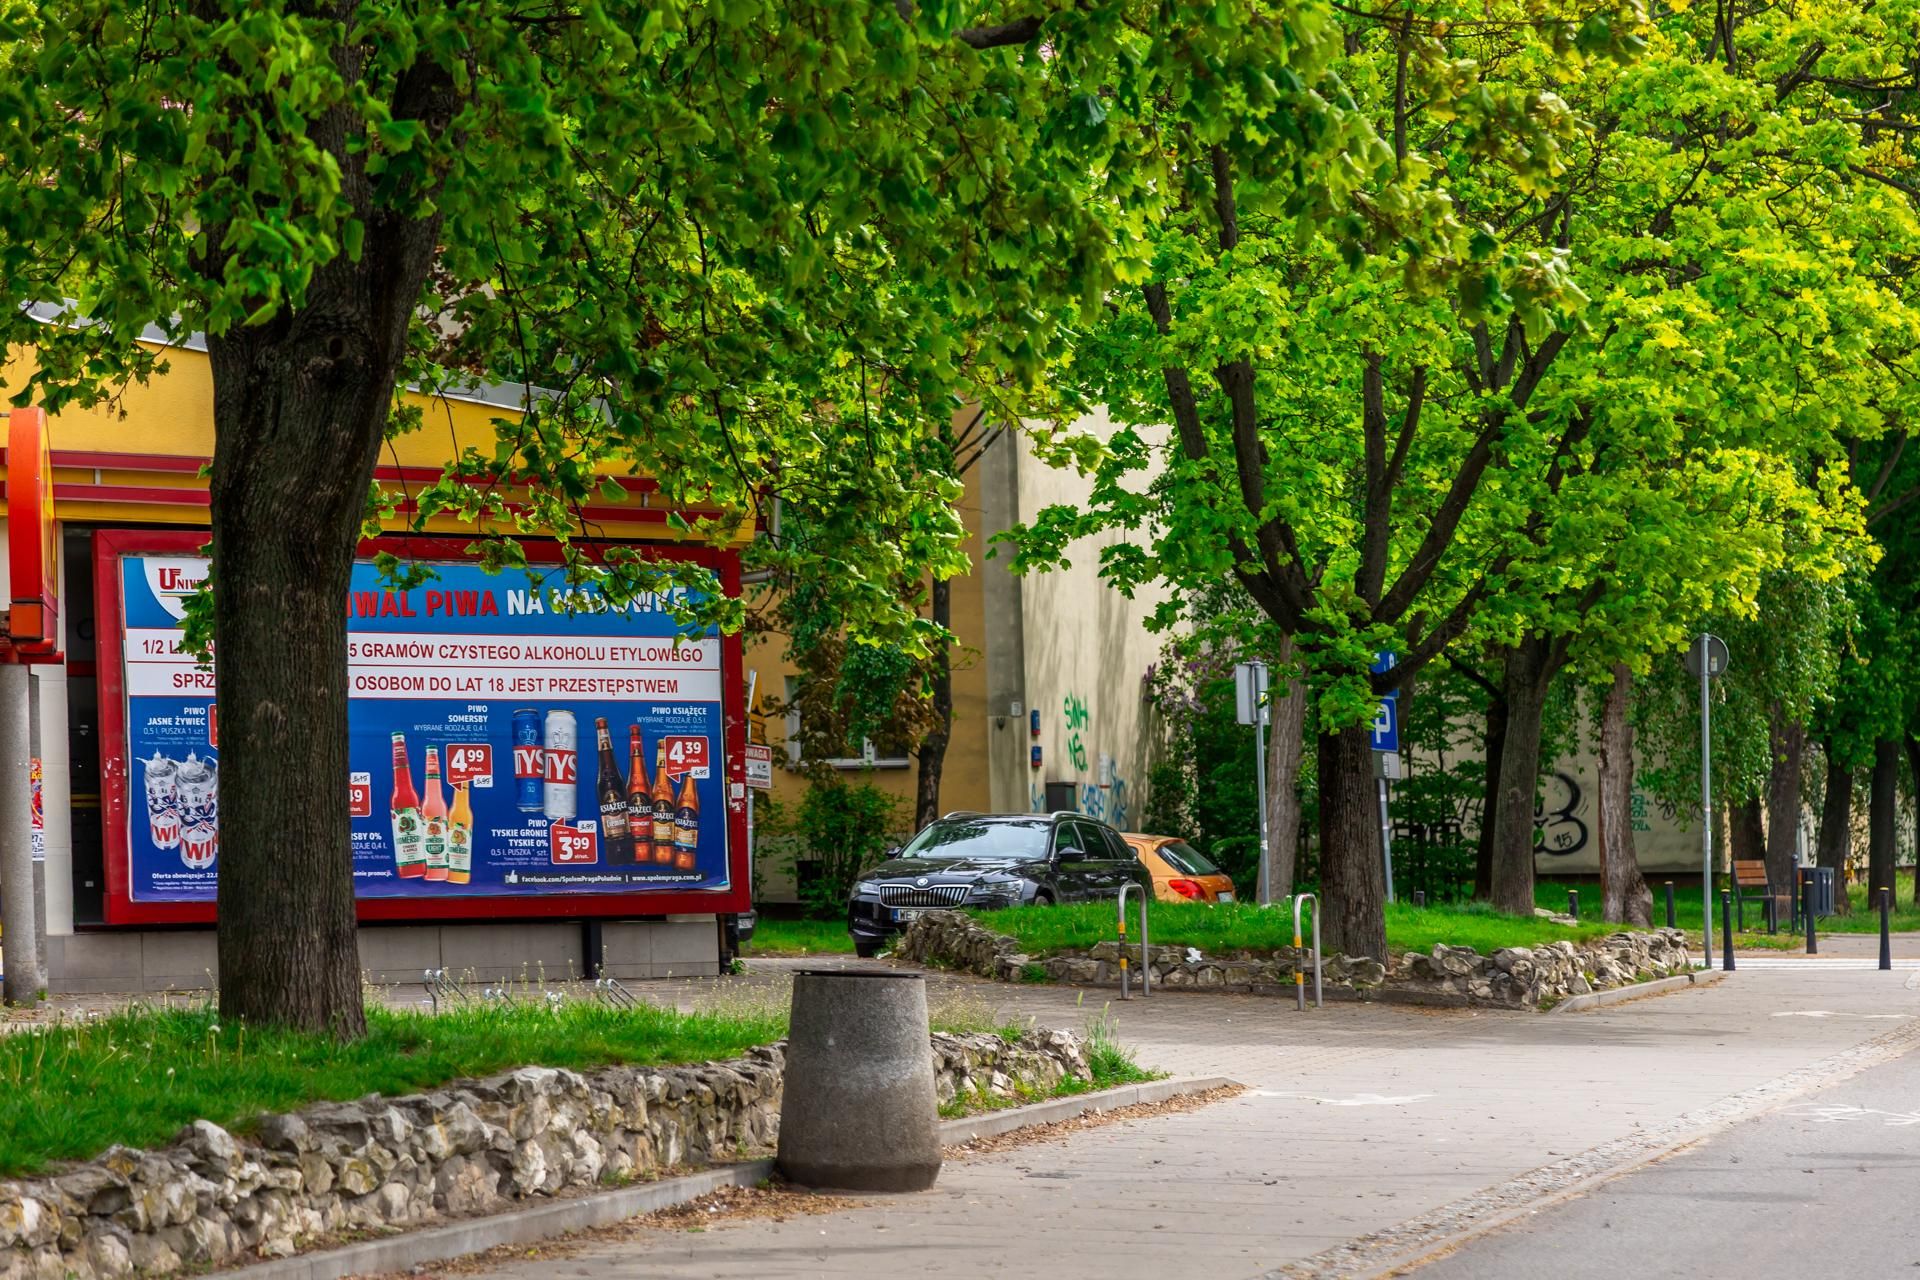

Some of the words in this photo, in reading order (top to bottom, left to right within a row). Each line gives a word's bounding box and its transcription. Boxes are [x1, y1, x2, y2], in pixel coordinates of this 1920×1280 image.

[426, 590, 499, 617] PIWA
[507, 589, 545, 615] NA
[142, 640, 164, 655] 1/2
[348, 643, 358, 658] 5
[362, 641, 434, 658] GRAMÓW
[439, 644, 520, 660] CZYSTEGO
[525, 646, 605, 661] ALKOHOLU
[611, 648, 703, 662] ETYLOWEGO
[173, 673, 216, 688] SPRZ
[356, 676, 424, 691] OSOBOM
[430, 677, 451, 692] DO
[457, 678, 483, 692] LAT
[488, 678, 504, 692] 18
[509, 678, 544, 692] JEST
[550, 678, 678, 696] PRZESTĘPSTWEM
[184, 707, 206, 715] PIWO
[467, 705, 488, 713] PIWO
[652, 707, 671, 715] PIWO
[673, 705, 707, 717] KSIĄŻĘCE
[147, 717, 173, 726] JASNE
[175, 715, 206, 726] ŻYWIEC
[448, 714, 488, 723] SOMERSBY
[637, 716, 664, 724] WYBRANE
[1376, 703, 1391, 744] P
[161, 727, 186, 735] PUSZKA
[413, 724, 444, 732] WYBRANE
[445, 724, 471, 732] RODZAJE
[528, 819, 548, 827] PIWO
[369, 832, 382, 841] 0%
[491, 829, 519, 837] TYSKIE
[520, 829, 548, 837] GRONIE
[351, 842, 371, 850] DZAJE
[508, 839, 534, 847] TYSKIE
[536, 839, 548, 847] 0%
[490, 849, 501, 857] 0,5
